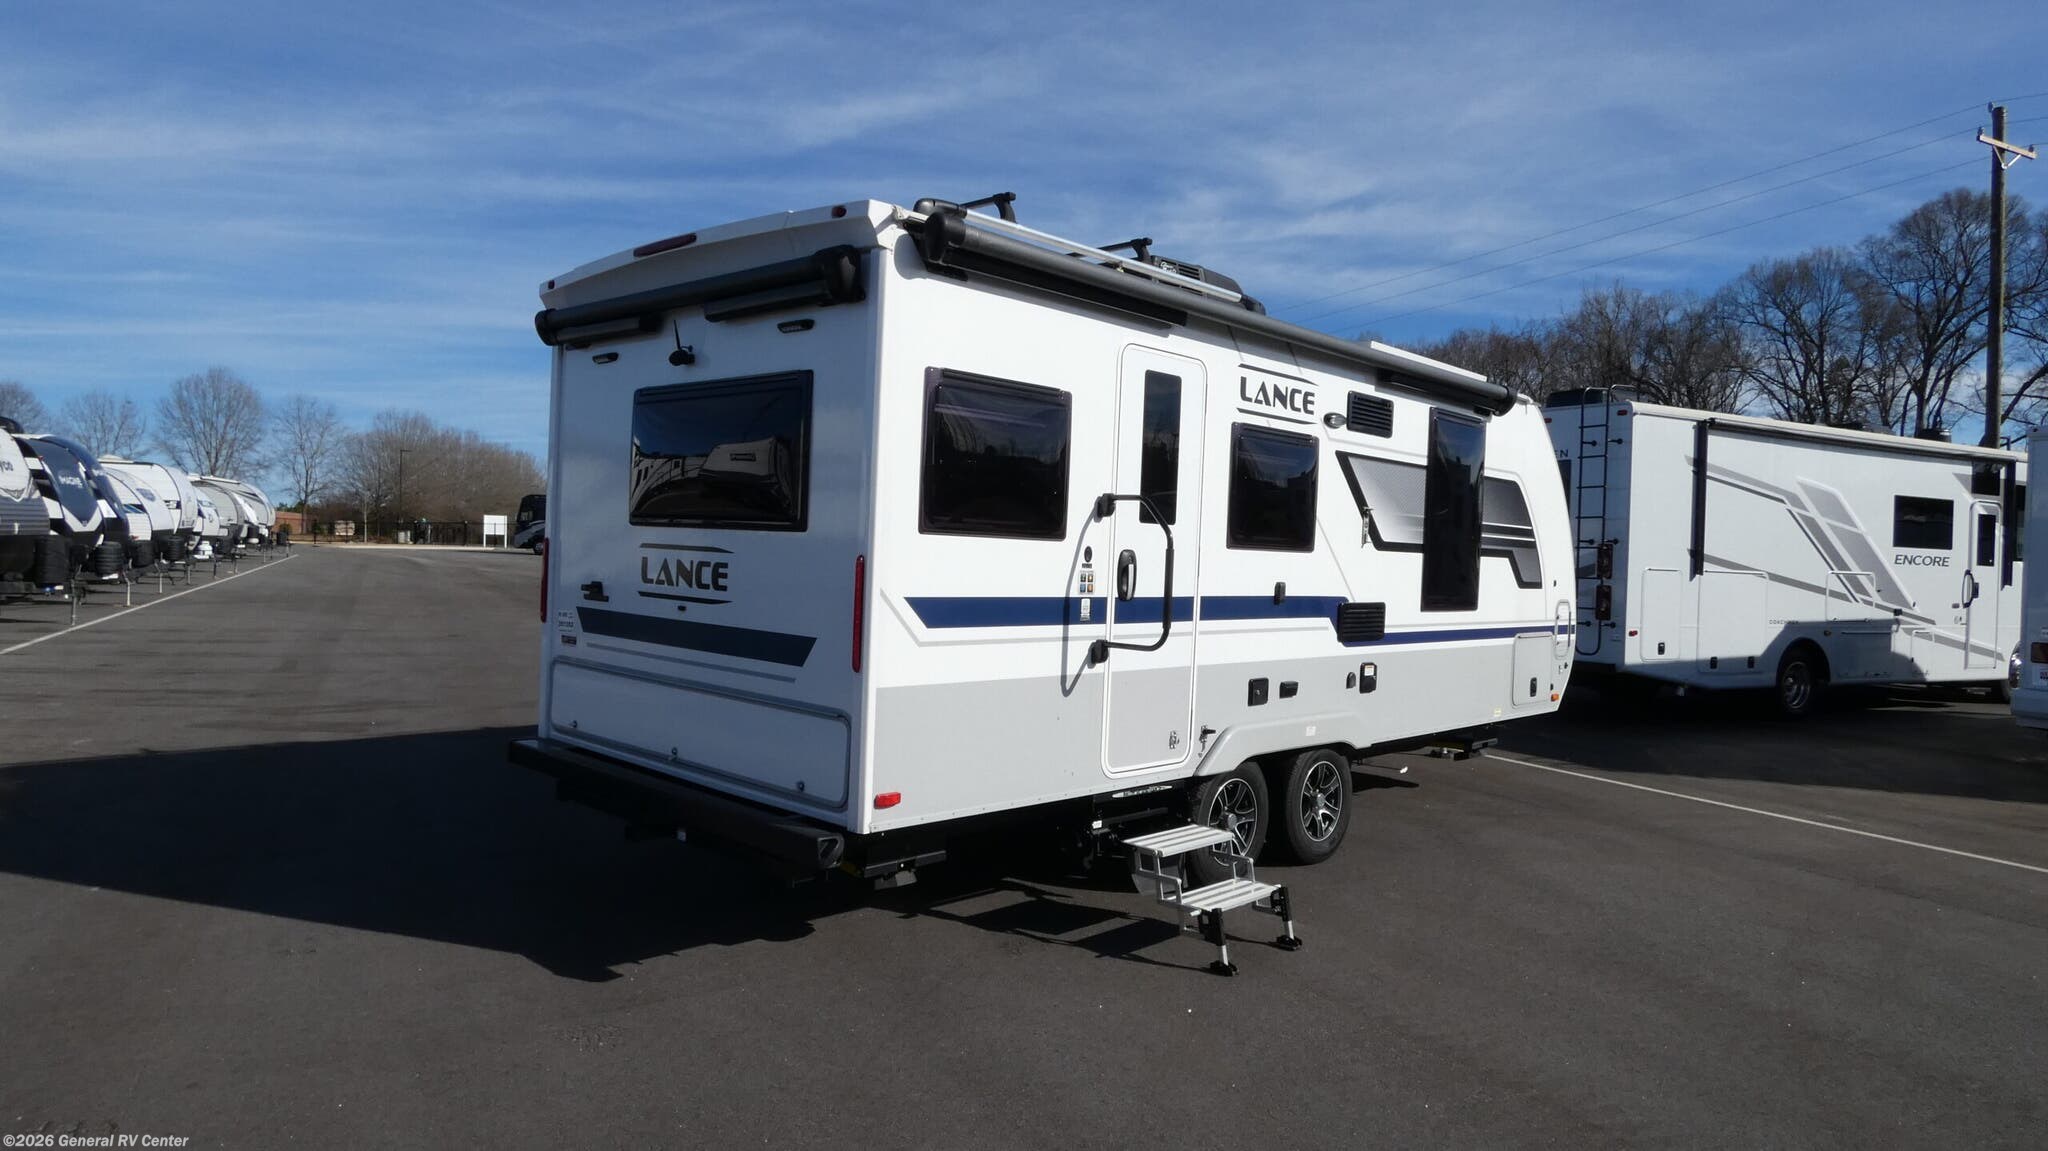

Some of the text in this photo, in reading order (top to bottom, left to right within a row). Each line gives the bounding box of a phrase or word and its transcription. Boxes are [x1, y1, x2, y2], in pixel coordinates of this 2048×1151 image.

[1240, 376, 1315, 415] LANCE
[641, 556, 728, 592] LANCE
[1894, 554, 1950, 567] ENCORE
